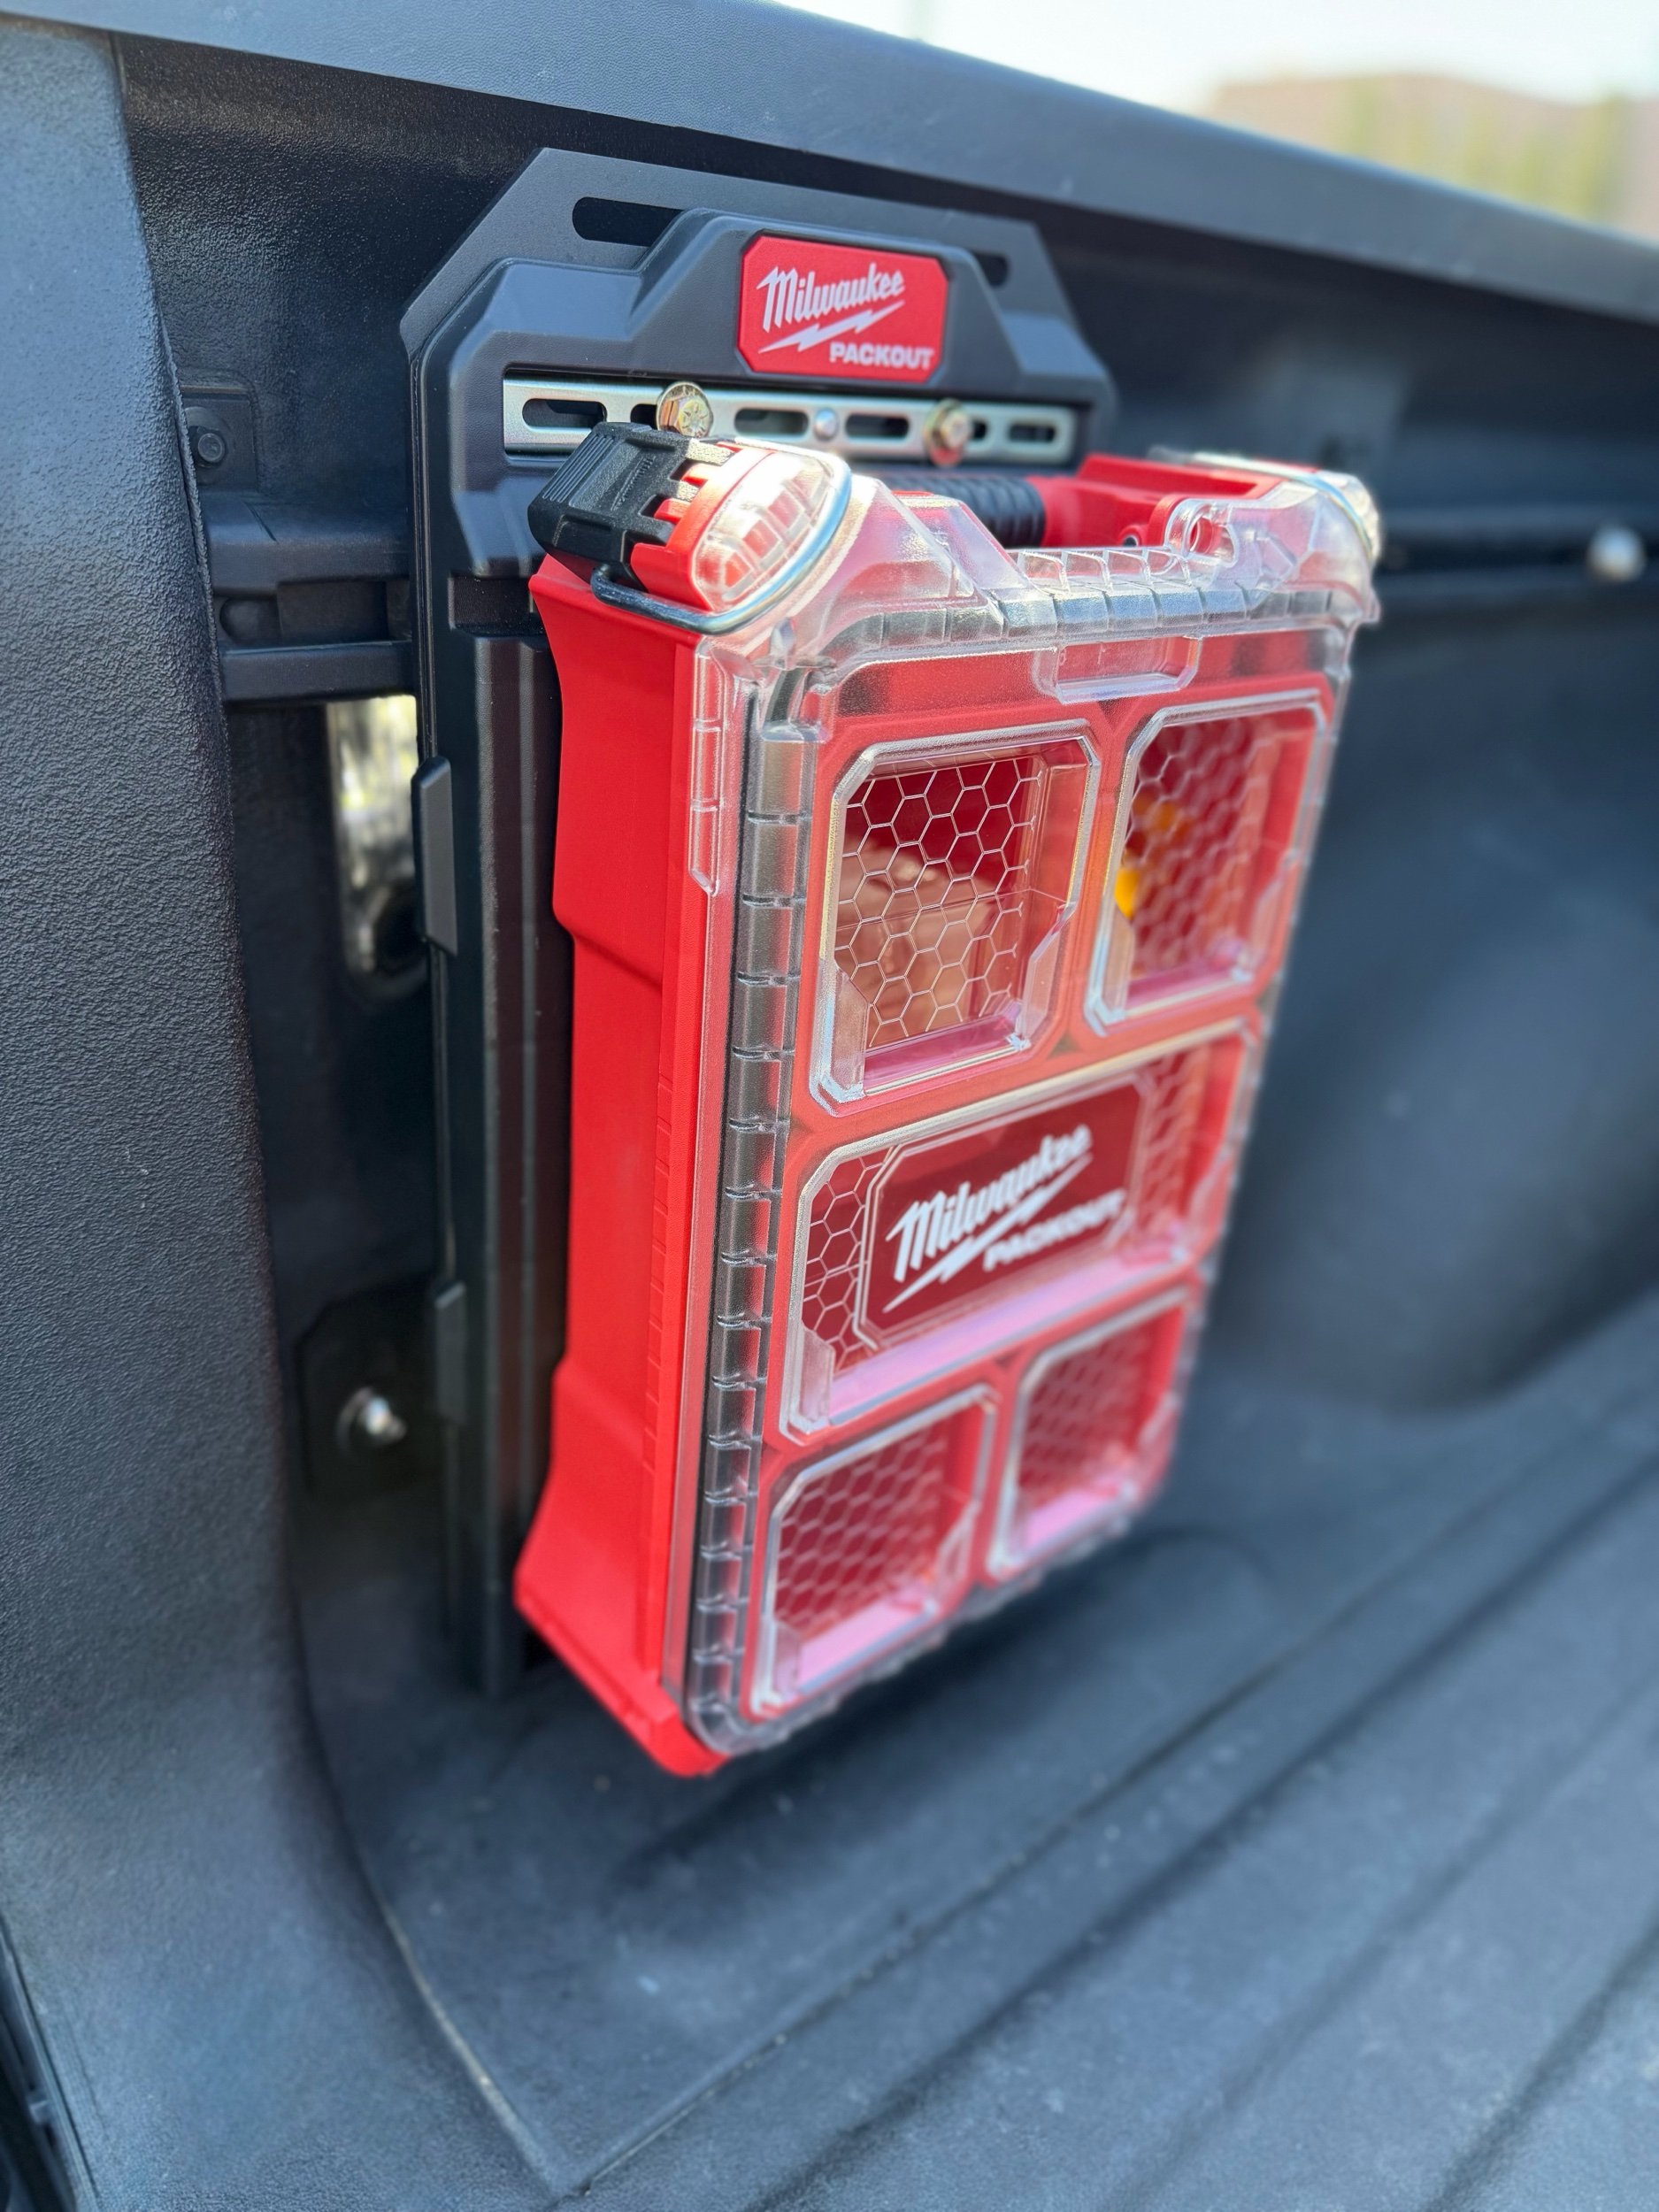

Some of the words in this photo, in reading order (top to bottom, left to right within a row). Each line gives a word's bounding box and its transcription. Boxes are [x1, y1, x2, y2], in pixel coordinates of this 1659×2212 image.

[757, 263, 904, 333] Milwaukee
[830, 342, 933, 370] PACKOUT
[886, 1125, 1092, 1282] Milwaukee
